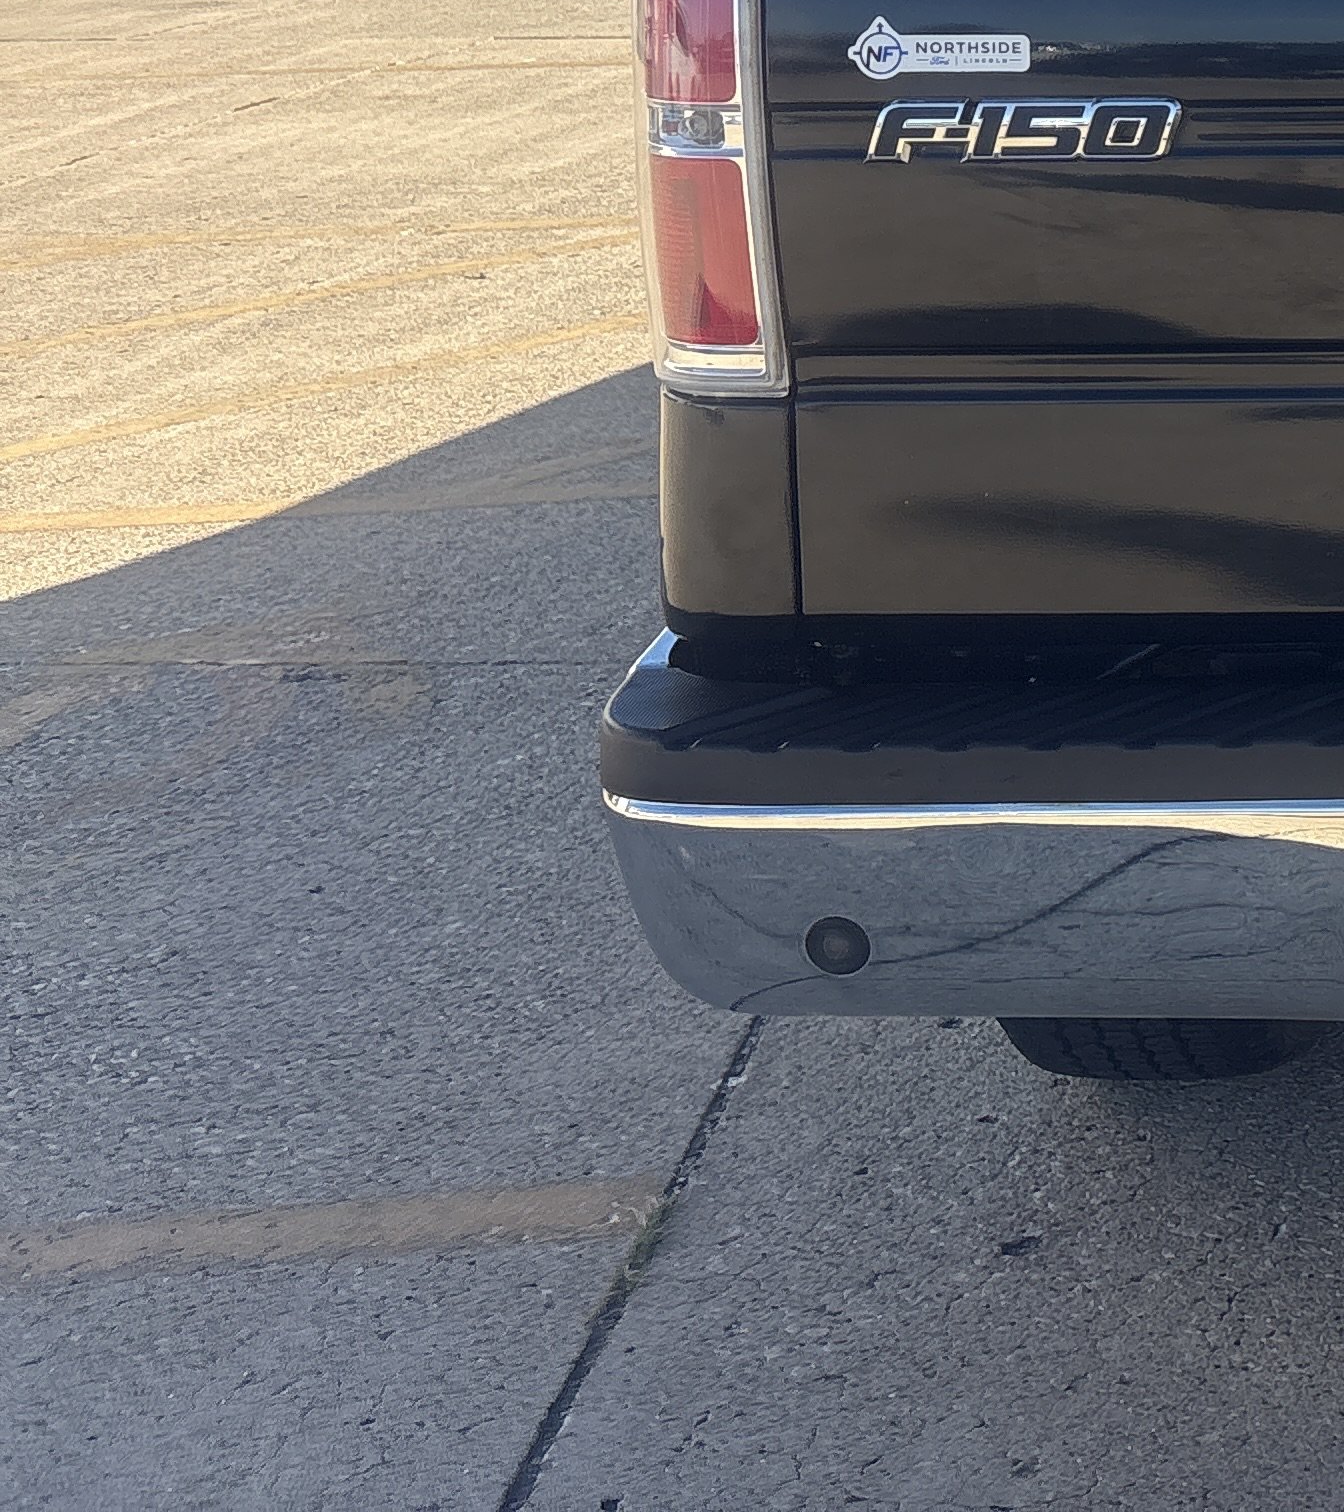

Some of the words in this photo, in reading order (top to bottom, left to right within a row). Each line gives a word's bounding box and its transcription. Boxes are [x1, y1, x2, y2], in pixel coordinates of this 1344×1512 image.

[915, 41, 1022, 54] NORTHSIDE
[867, 45, 900, 68] NF
[929, 56, 951, 66] Ford
